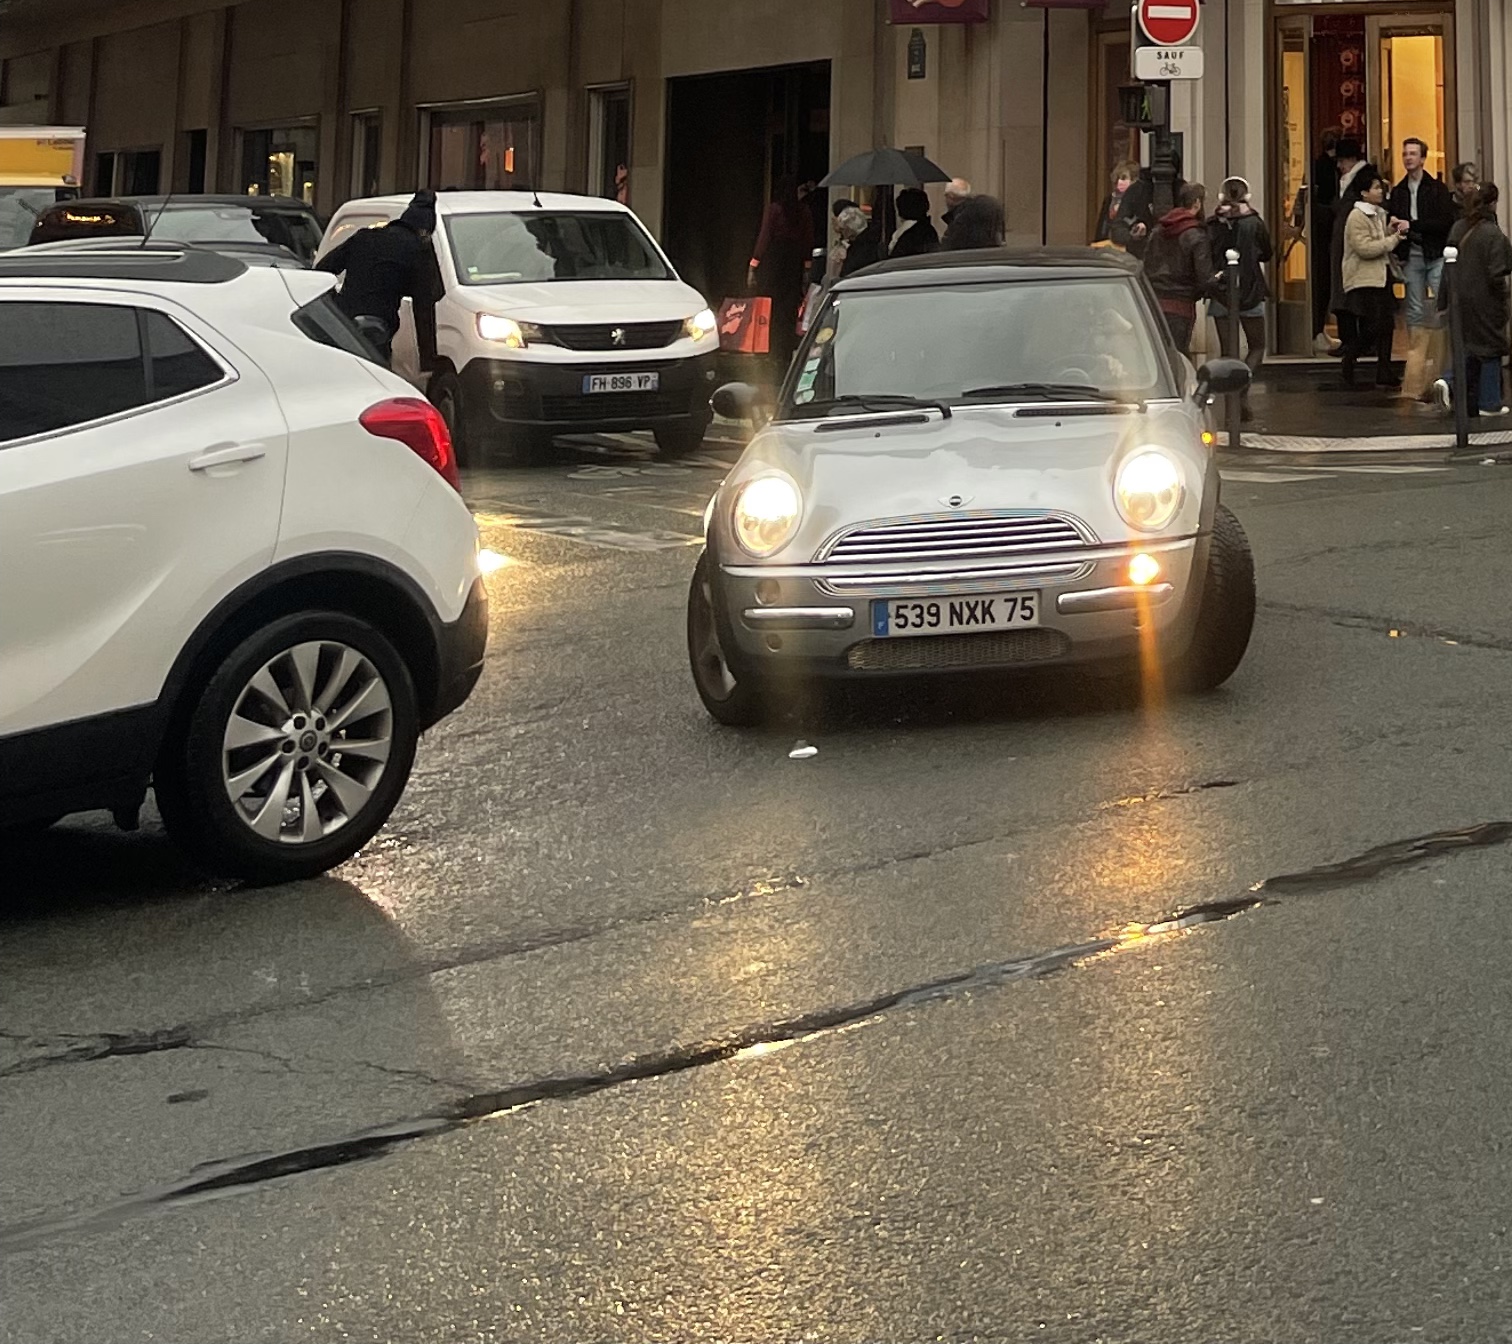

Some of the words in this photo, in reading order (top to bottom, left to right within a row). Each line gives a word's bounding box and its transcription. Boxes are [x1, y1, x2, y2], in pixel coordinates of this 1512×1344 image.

[1156, 51, 1185, 61] SAUF
[894, 602, 941, 630] 539
[949, 599, 996, 627] NXK
[1003, 596, 1035, 622] 75
